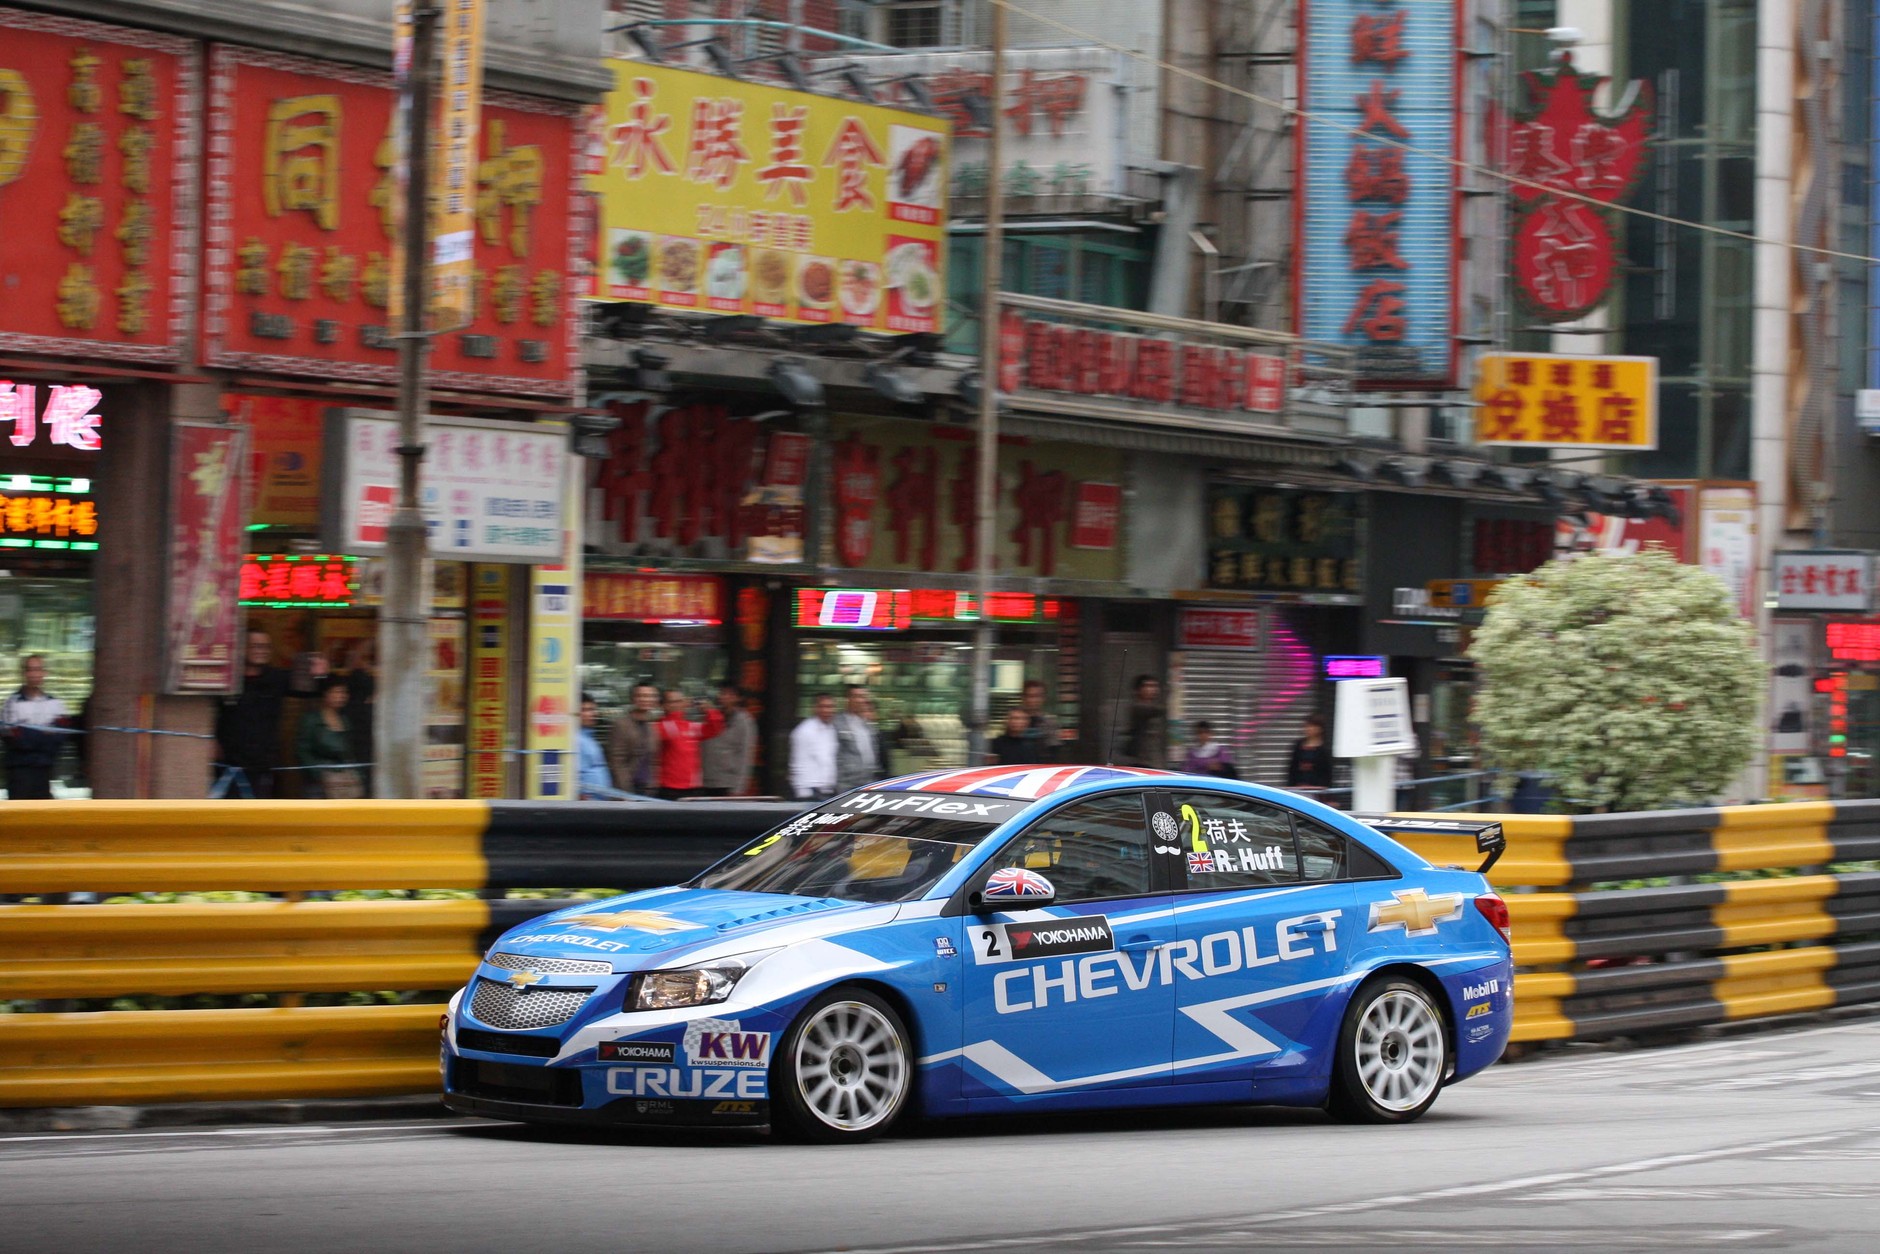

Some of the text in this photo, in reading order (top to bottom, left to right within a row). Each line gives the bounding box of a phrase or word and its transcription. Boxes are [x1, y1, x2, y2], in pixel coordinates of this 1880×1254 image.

[841, 793, 1005, 816] HyFlex
[1181, 804, 1208, 852] 2
[1203, 819, 1251, 844] 荷夫
[1214, 846, 1283, 872] R. Huff
[508, 934, 630, 952] CHEVROLET
[982, 931, 1001, 957] 2
[1033, 926, 1108, 946] YOKOHAMA
[993, 909, 1343, 1015] CHEVROLET
[1463, 982, 1490, 1000] Mobil
[617, 1047, 672, 1058] YOKOHAMA
[699, 1032, 769, 1060] KW
[691, 1059, 766, 1068] kwsuspensions.de
[607, 1067, 766, 1099] CRUZE
[649, 1101, 674, 1109] RML
